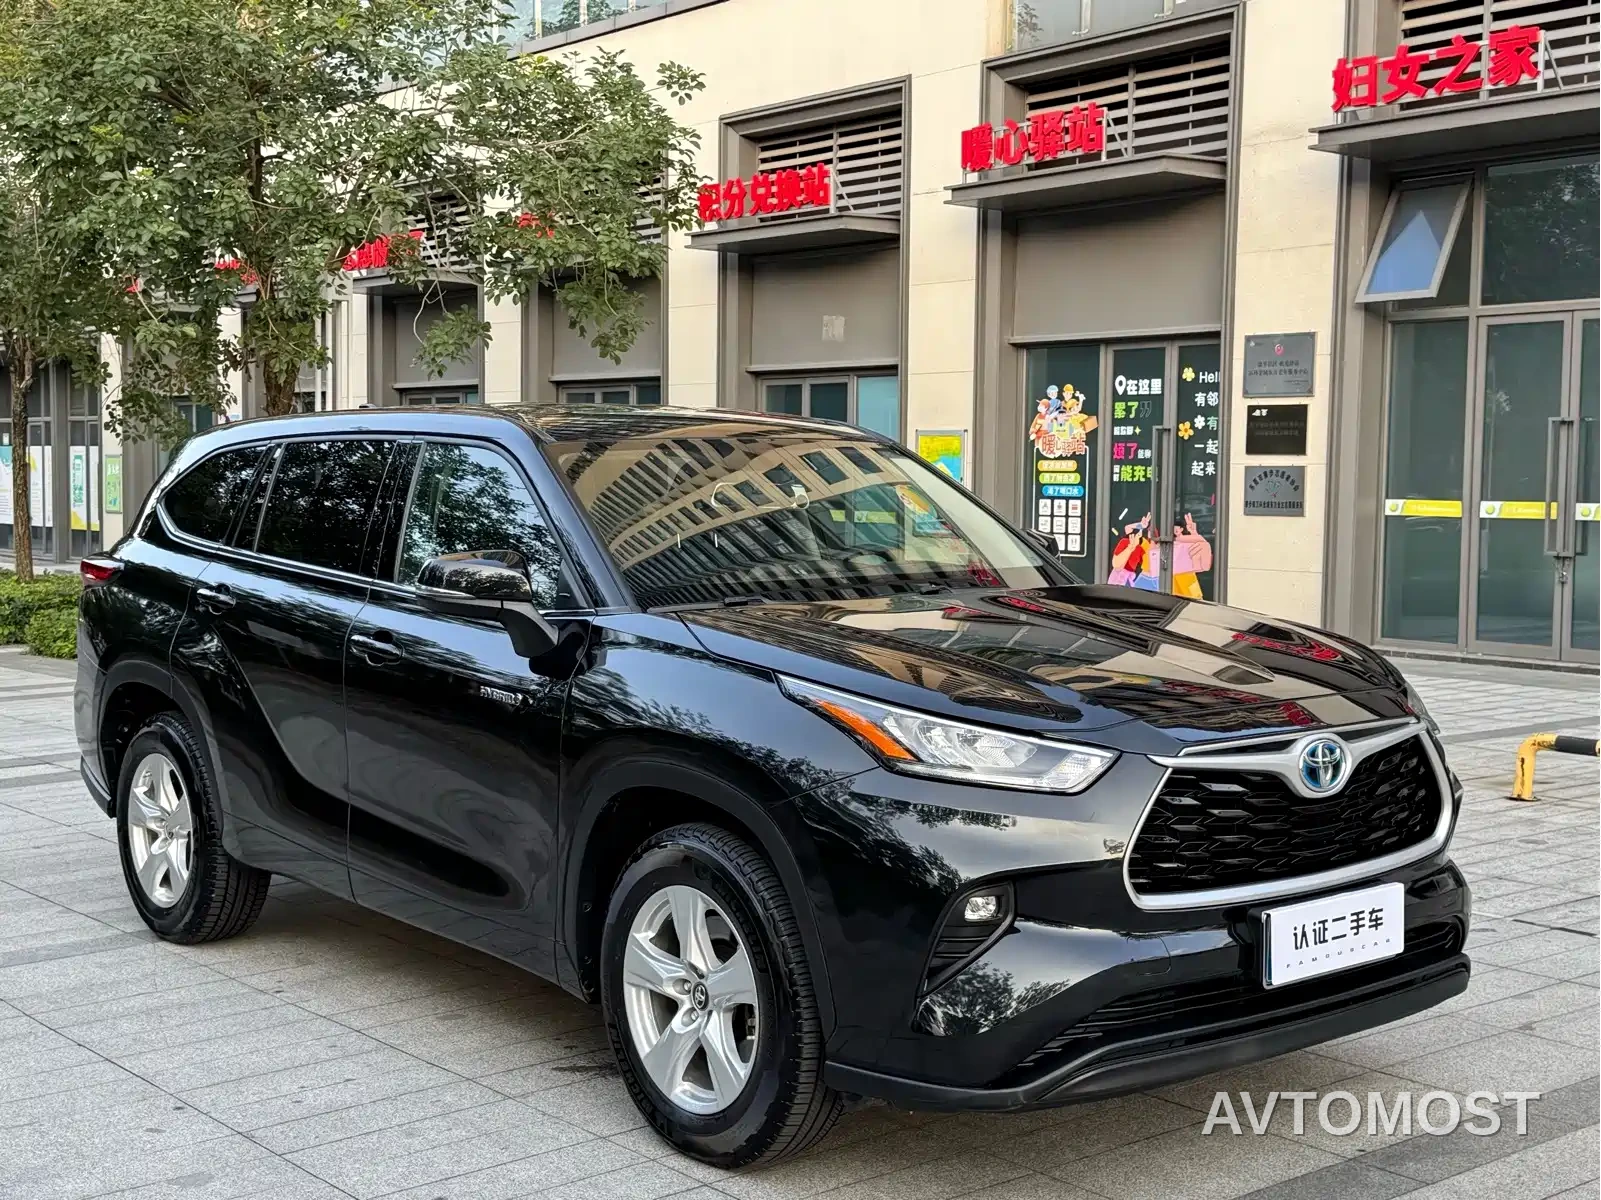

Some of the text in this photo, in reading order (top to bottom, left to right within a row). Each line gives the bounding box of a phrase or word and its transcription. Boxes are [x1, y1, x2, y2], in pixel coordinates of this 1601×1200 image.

[1331, 24, 1541, 112] 妇女之家
[961, 102, 1105, 172] 暖心驿站
[697, 162, 831, 222] 积分兑换站
[1126, 378, 1162, 395] 在这里
[1114, 401, 1139, 419] 累了
[1206, 416, 1219, 431] 有
[1194, 439, 1219, 455] 一起
[1191, 460, 1216, 477] 起来
[1293, 907, 1384, 951] 认证二手车
